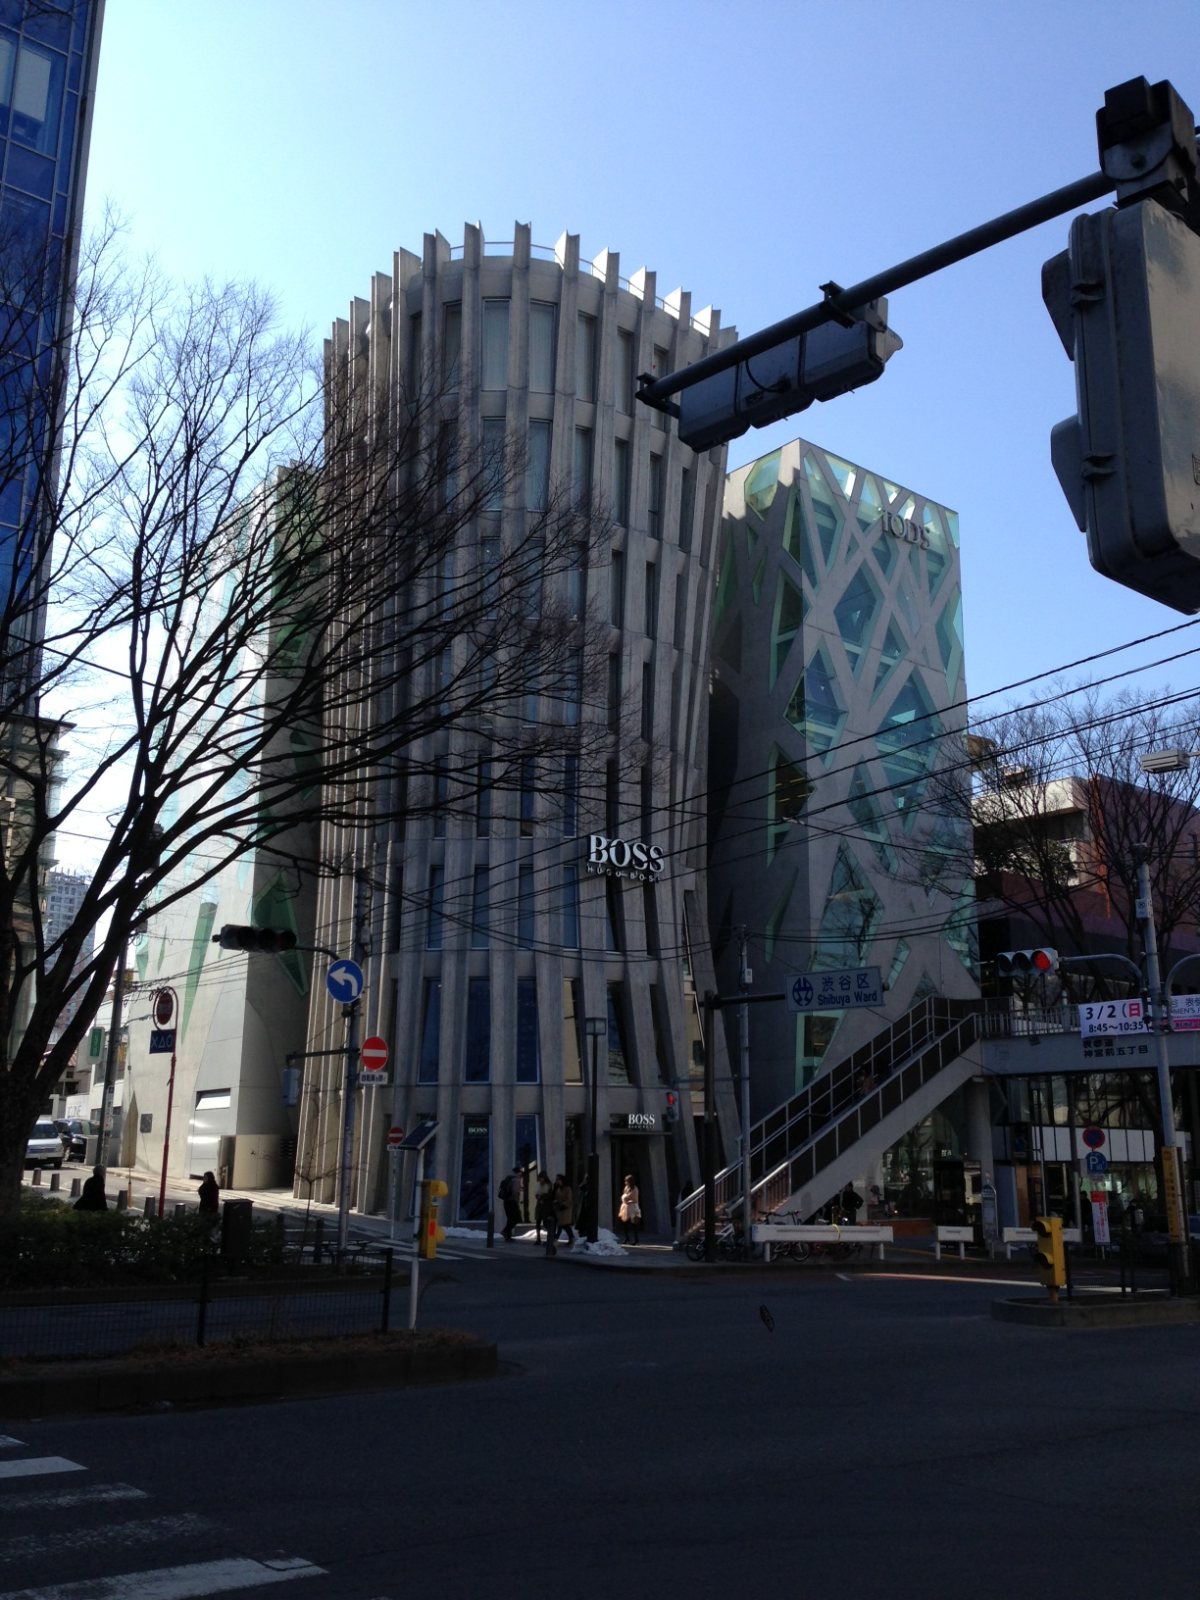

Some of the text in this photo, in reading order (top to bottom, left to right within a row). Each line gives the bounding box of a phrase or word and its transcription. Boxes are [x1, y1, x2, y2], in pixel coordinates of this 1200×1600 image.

[588, 834, 665, 873] BOSS
[821, 973, 870, 992] 渋谷区
[817, 989, 878, 1006] Shibuya Ward
[1084, 1045, 1148, 1058] 神宮前五丁目
[628, 1113, 656, 1125] BOSS
[1089, 1156, 1098, 1170] P
